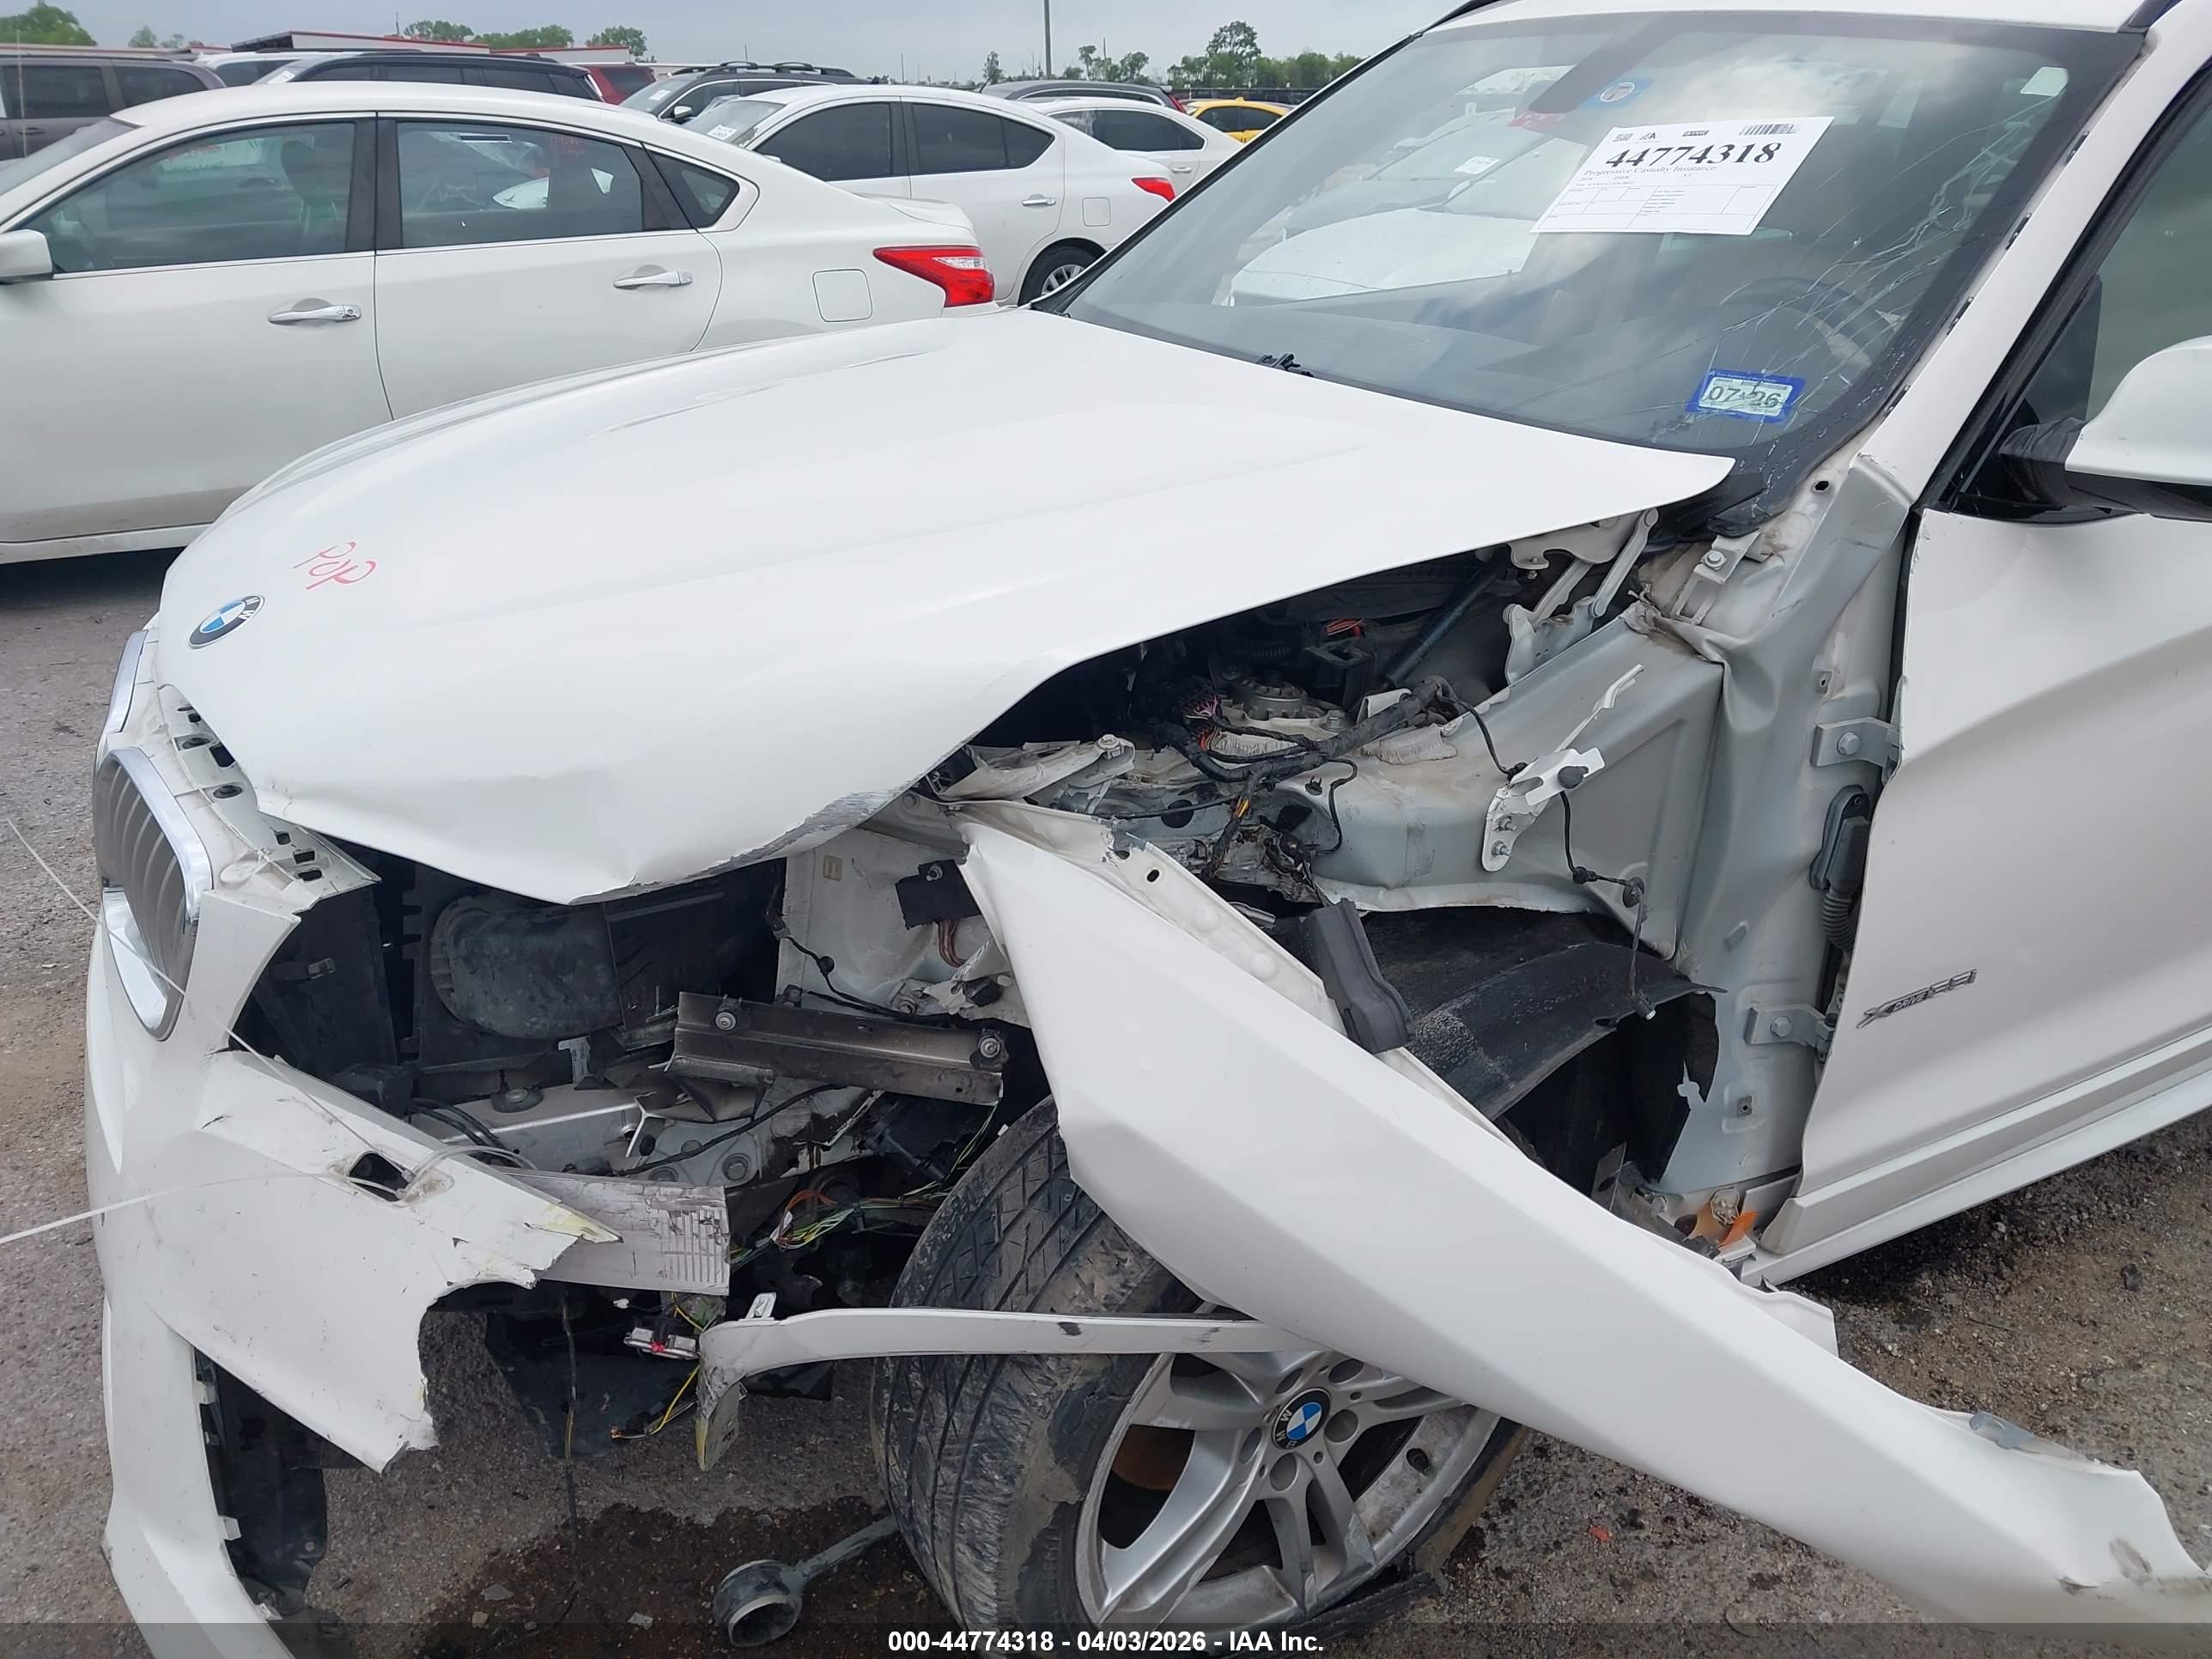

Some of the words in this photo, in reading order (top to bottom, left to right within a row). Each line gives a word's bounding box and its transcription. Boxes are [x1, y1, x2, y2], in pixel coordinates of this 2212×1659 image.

[1606, 143, 1782, 167] 44774318
[1583, 168, 1633, 177] Progressive
[1705, 386, 1741, 402] 07
